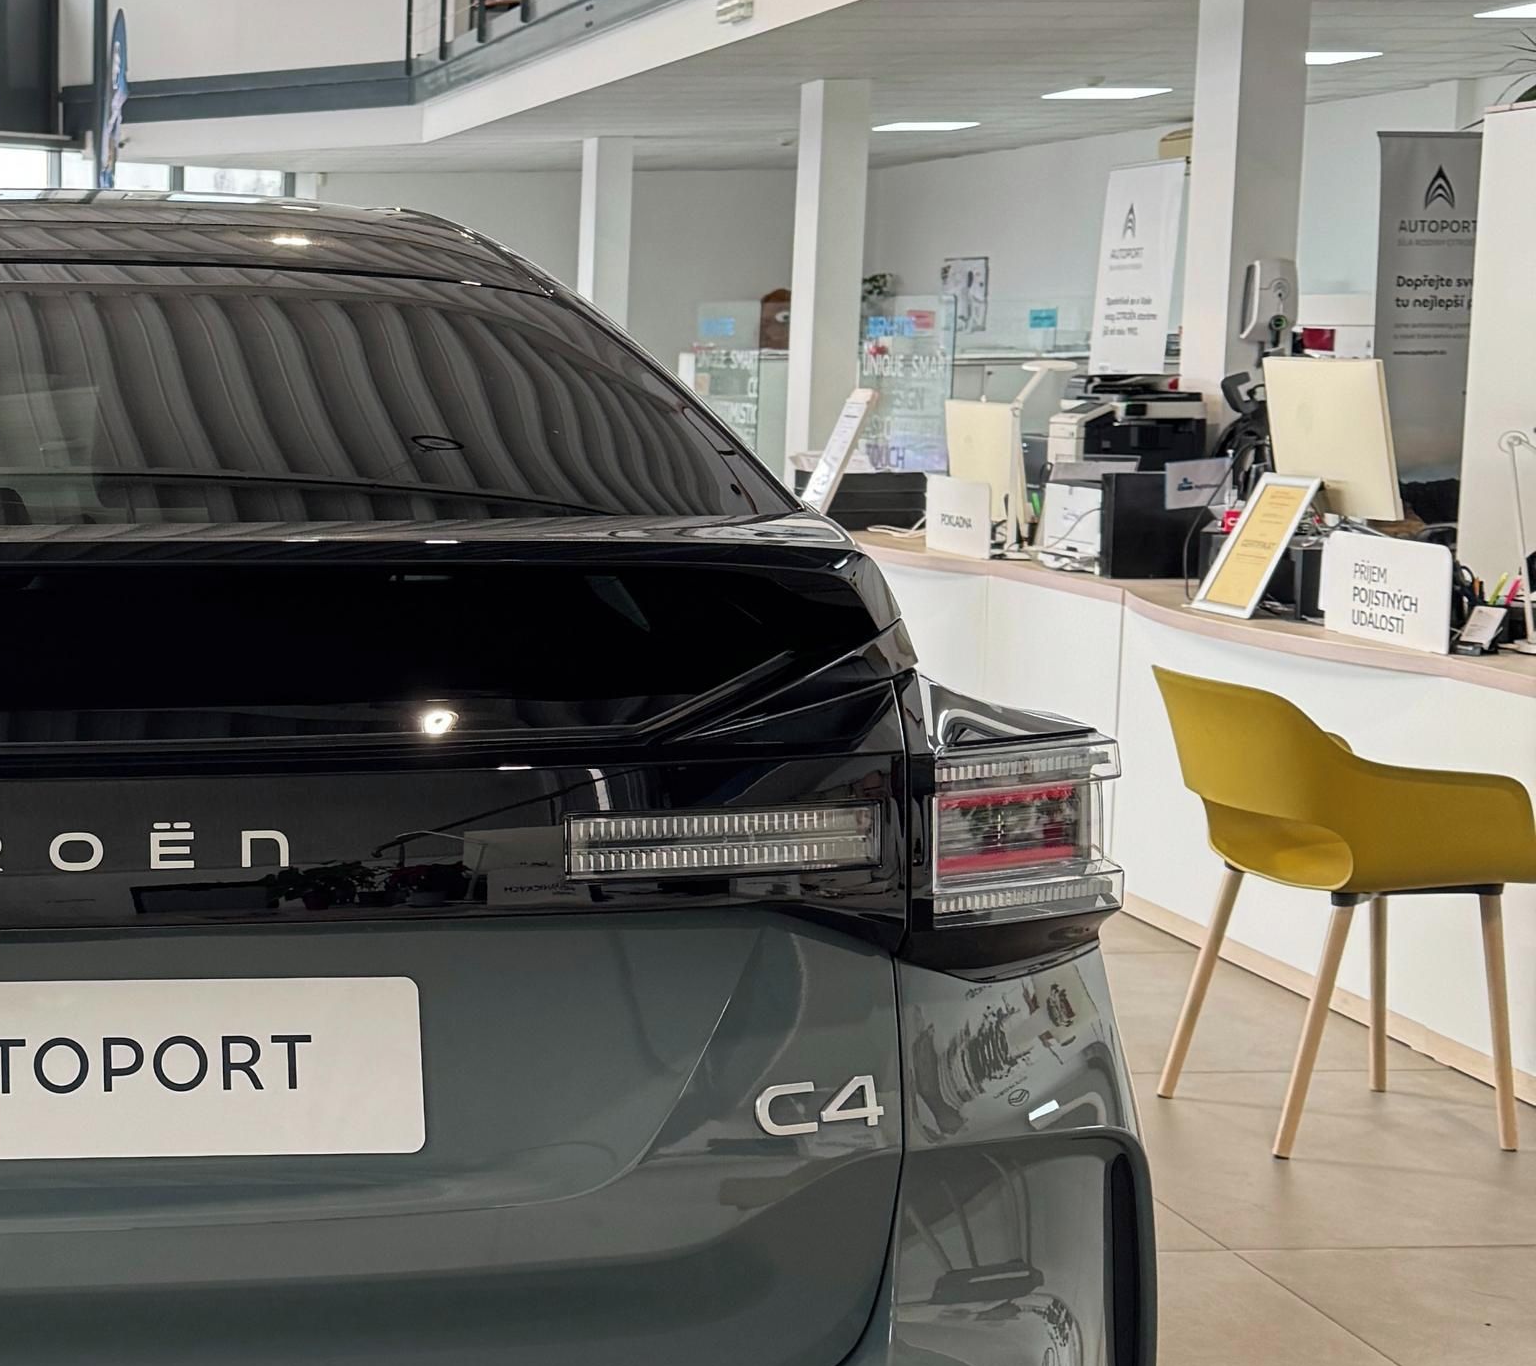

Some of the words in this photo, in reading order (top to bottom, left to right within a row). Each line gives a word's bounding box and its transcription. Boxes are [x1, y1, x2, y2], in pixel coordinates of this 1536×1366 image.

[1398, 219, 1477, 233] AUTOPORT
[1396, 275, 1453, 291] Dopřejte
[1413, 294, 1465, 311] nejlepší
[940, 513, 973, 529] POKLADNA
[1352, 586, 1418, 613] POJISTNÝCH
[1351, 608, 1405, 635] UDÁLOSTÍ
[755, 1075, 884, 1136] C4
